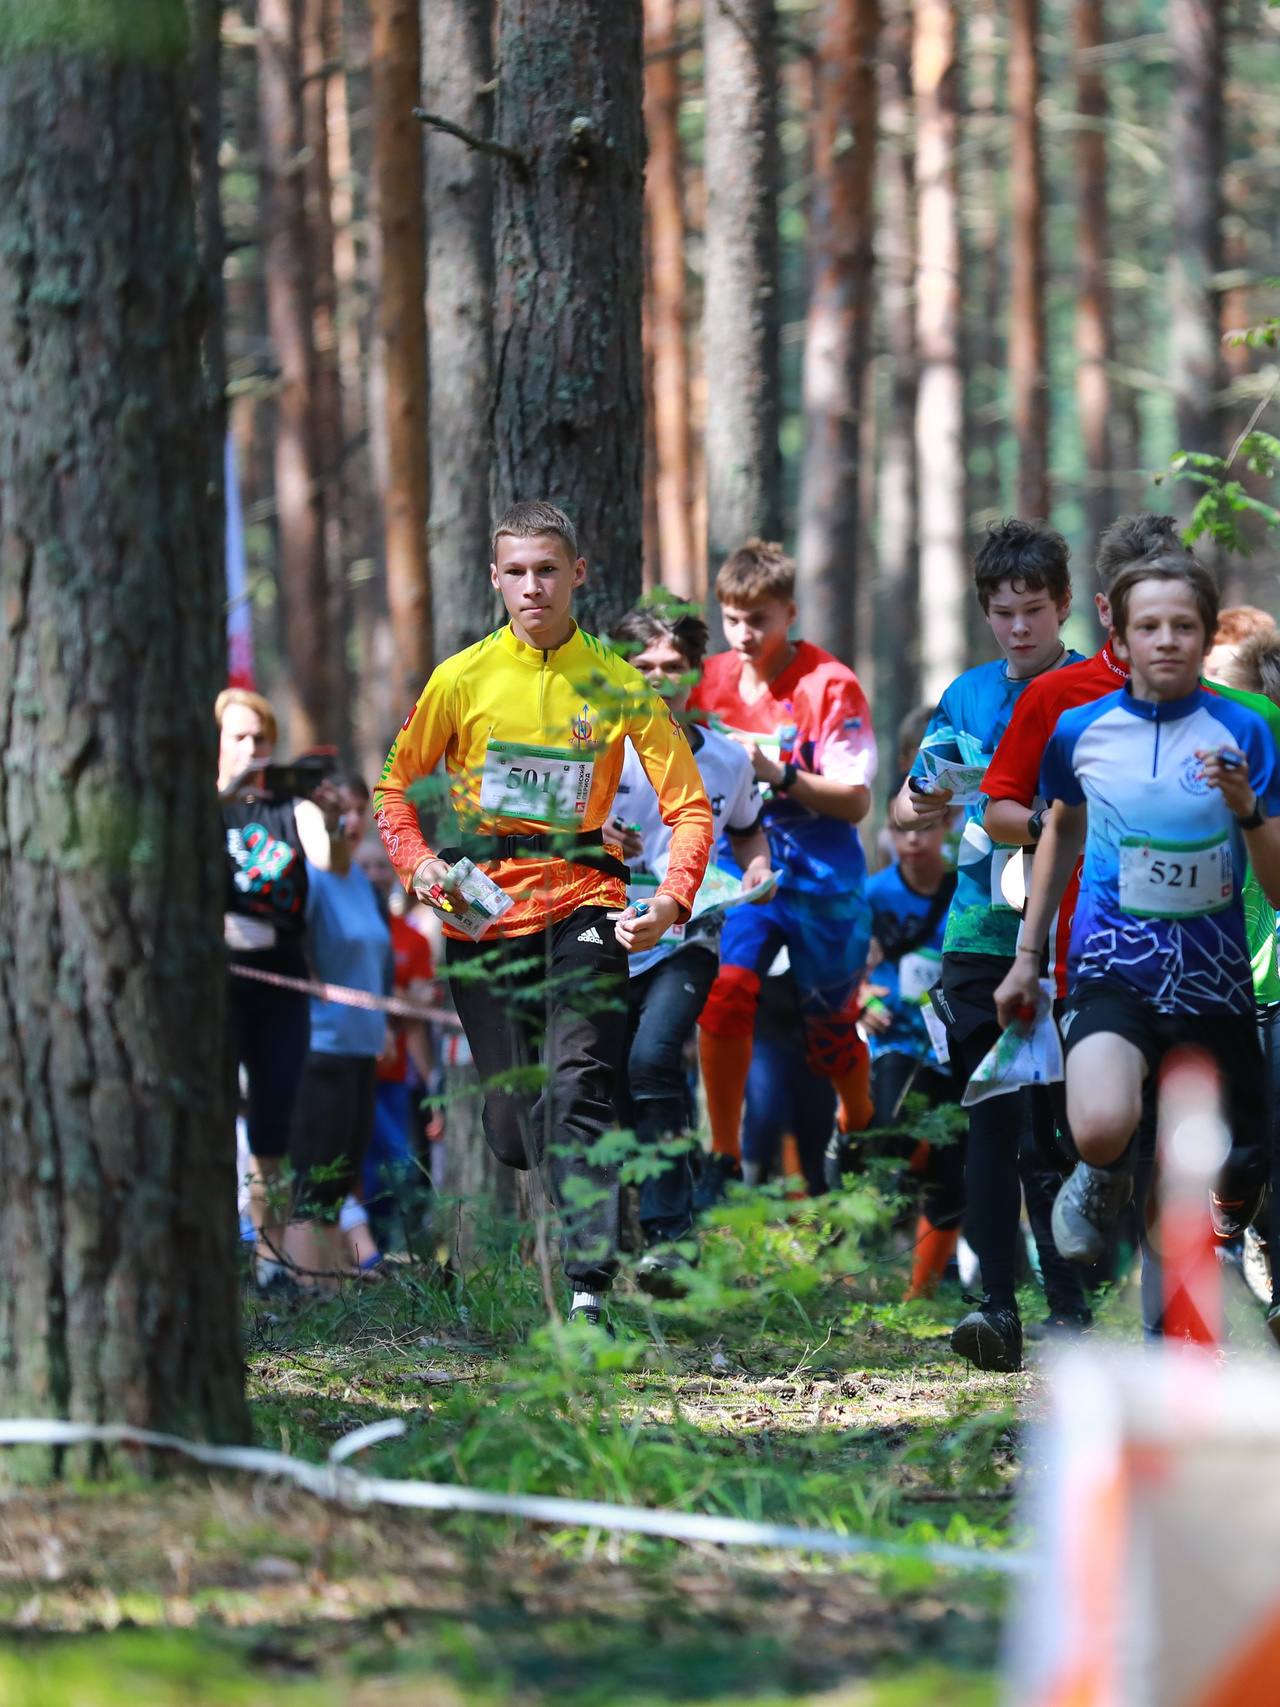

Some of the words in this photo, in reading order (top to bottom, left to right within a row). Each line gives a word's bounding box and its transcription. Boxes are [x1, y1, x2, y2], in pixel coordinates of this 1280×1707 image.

[506, 767, 551, 793] 501
[1149, 861, 1198, 888] 521
[577, 935, 604, 945] adidas
